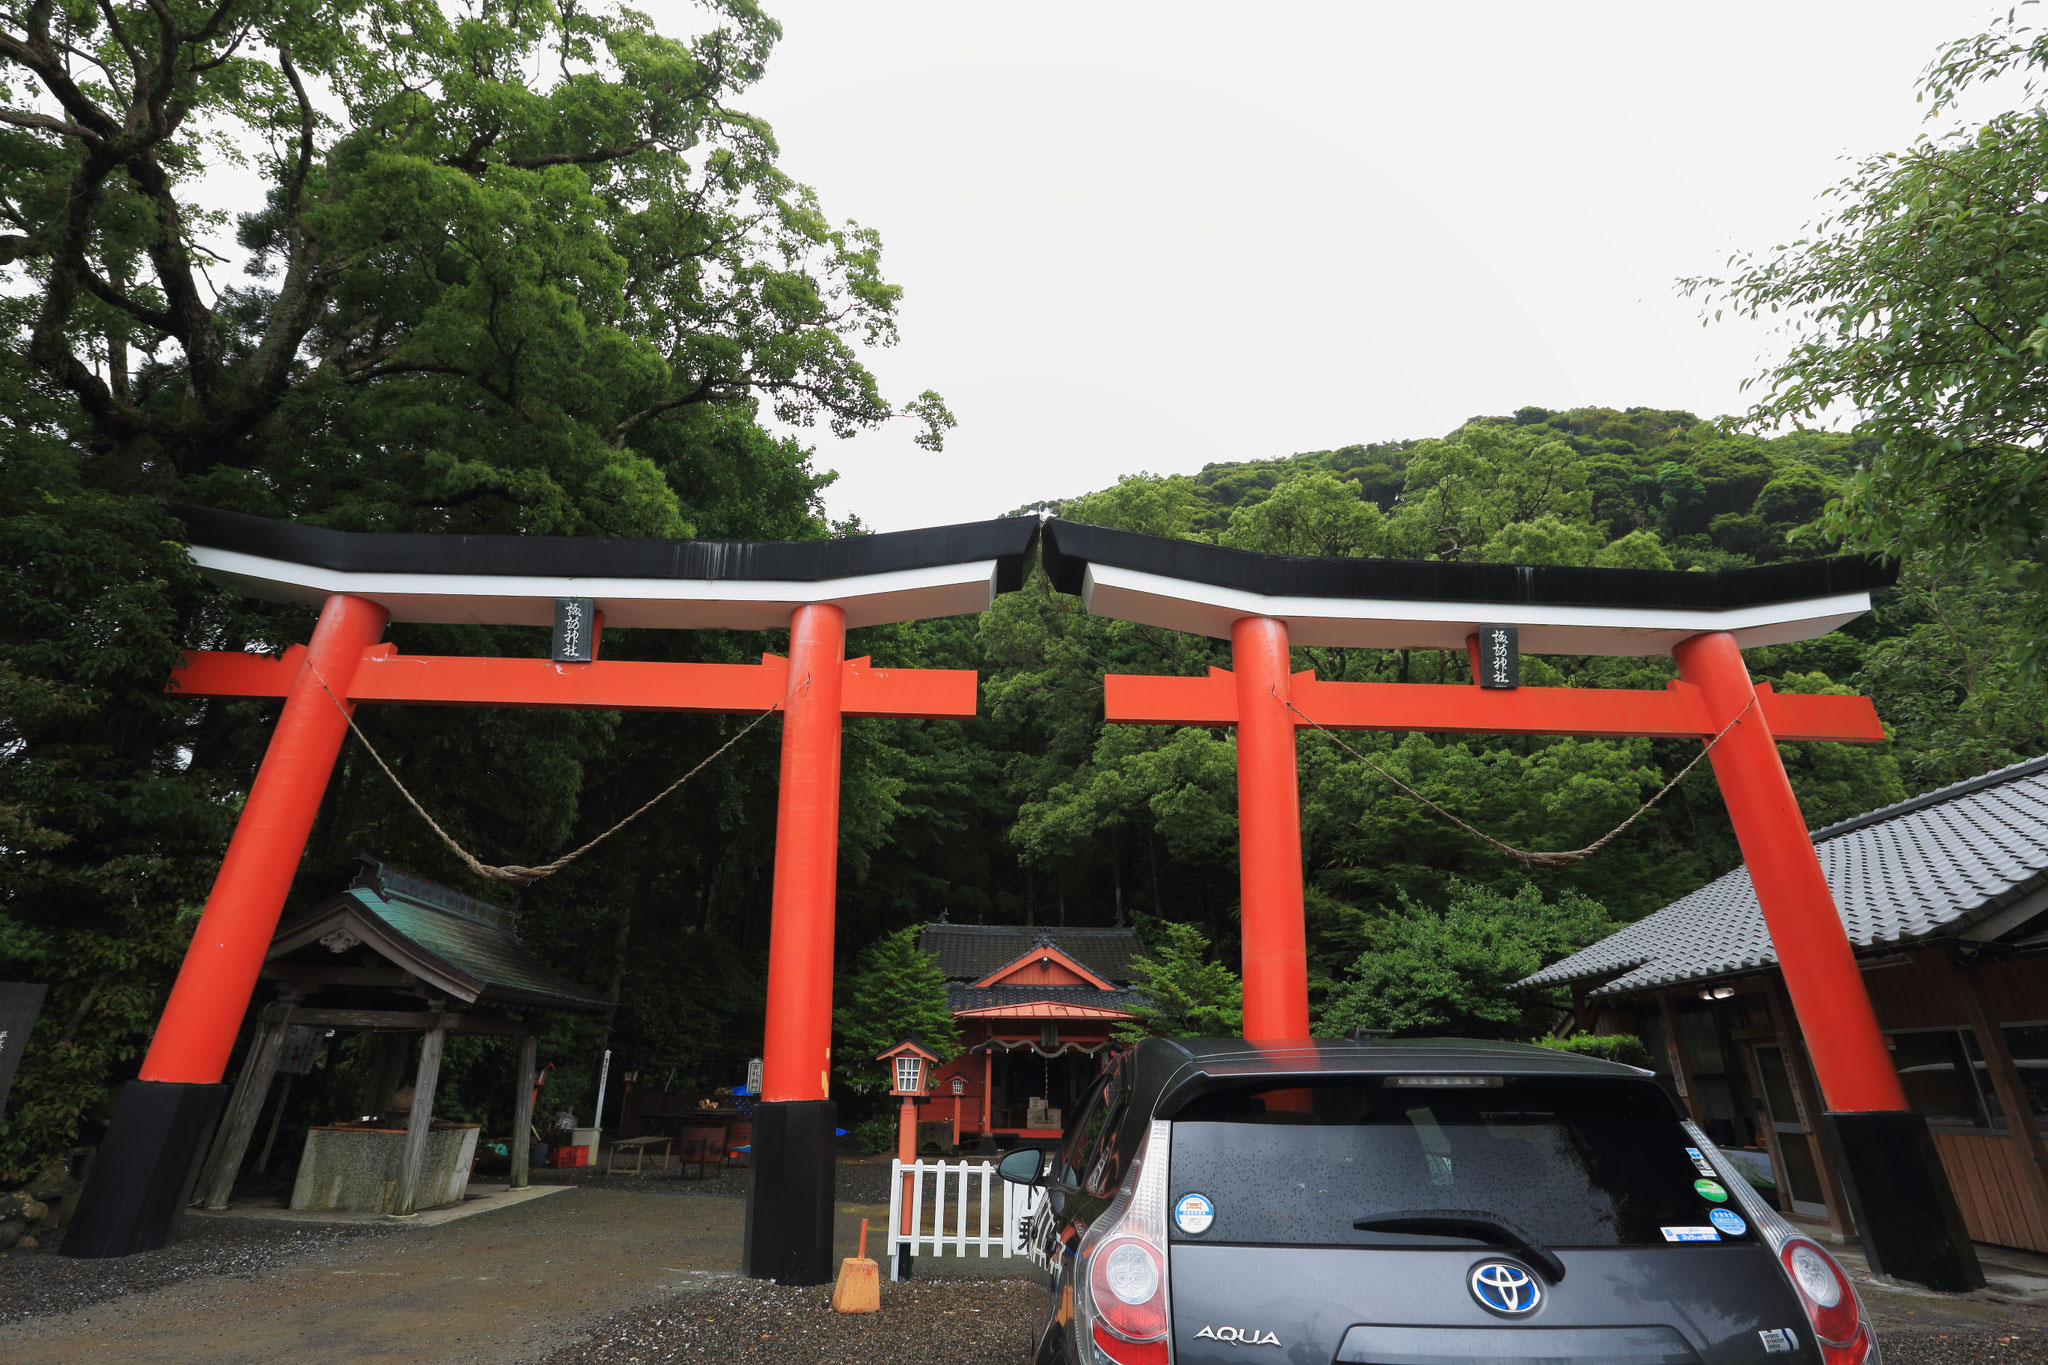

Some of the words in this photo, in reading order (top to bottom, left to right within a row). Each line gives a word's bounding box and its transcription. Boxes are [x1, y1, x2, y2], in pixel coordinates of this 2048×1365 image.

[562, 602, 582, 657] 諏訪神社
[1491, 629, 1510, 684] 諏訪神社
[1192, 1325, 1282, 1347] AQUA
